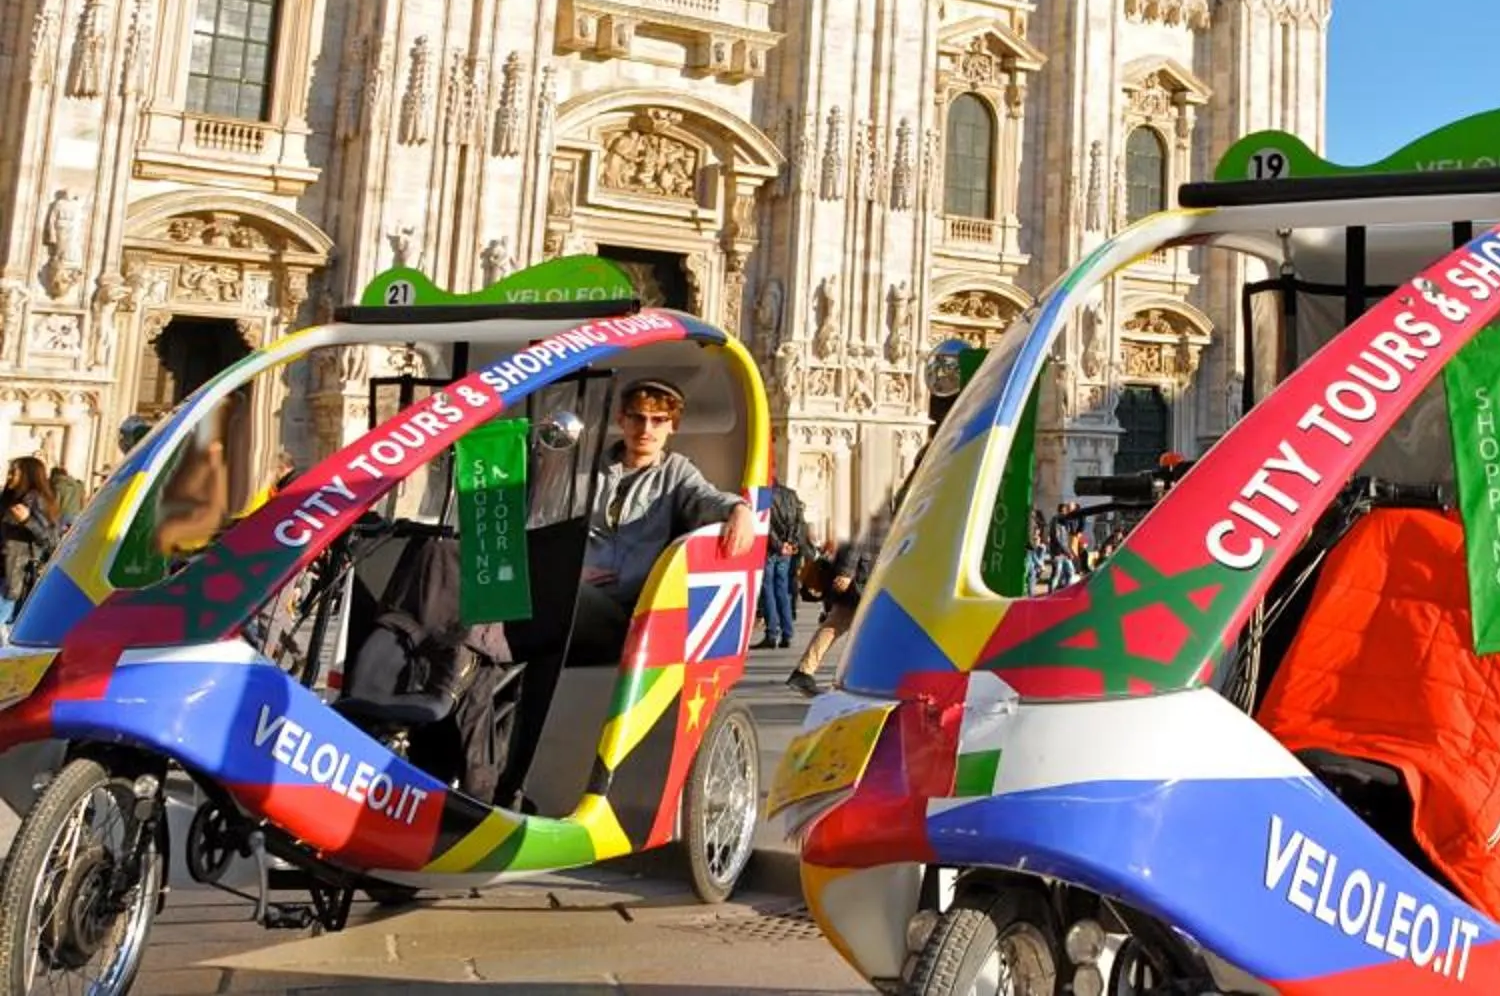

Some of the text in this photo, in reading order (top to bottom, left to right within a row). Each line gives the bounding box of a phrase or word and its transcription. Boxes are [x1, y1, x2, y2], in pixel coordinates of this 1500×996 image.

[1252, 153, 1284, 180] 19
[388, 284, 409, 305] 21
[273, 476, 358, 549] CITY
[348, 399, 464, 479] TOURS
[456, 383, 491, 409] &
[479, 324, 608, 392] SHOPPING
[1206, 439, 1323, 570] CITY
[1297, 311, 1442, 446] TOURS
[1412, 276, 1472, 324] &
[473, 459, 491, 585] SHOPPING
[494, 488, 509, 551] TOUR
[254, 703, 428, 825] VELOLEO.IT
[1264, 813, 1480, 983] VELOLEO.IT
